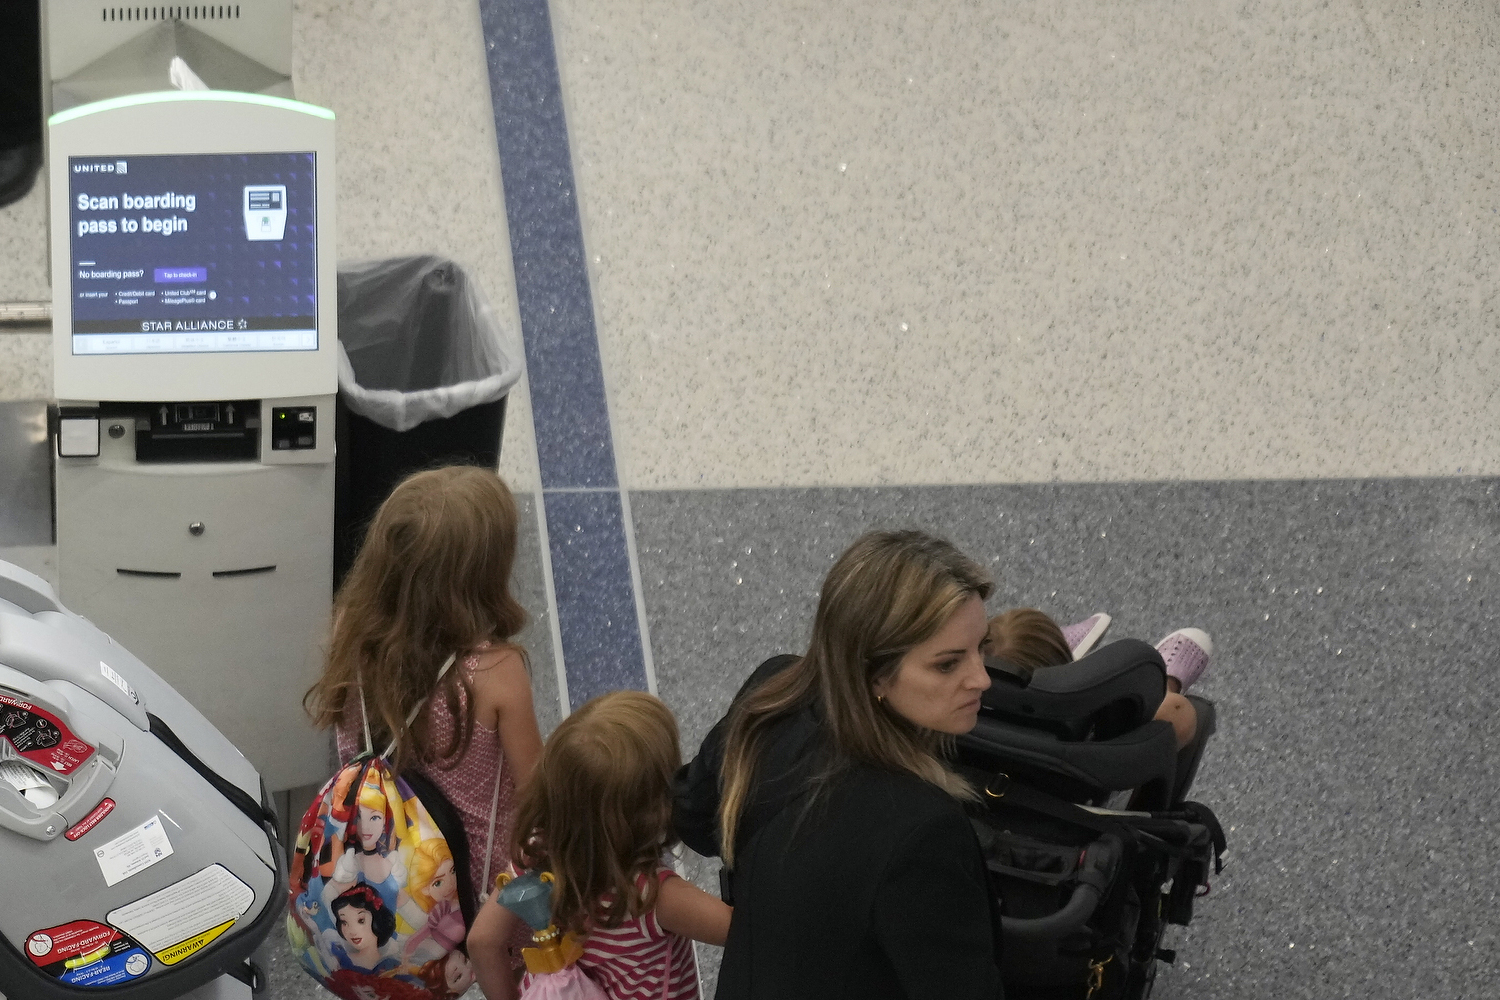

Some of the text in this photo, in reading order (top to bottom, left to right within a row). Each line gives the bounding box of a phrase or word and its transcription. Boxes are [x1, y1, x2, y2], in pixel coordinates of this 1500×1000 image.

[74, 164, 115, 173] UNITED
[77, 192, 196, 213] Scan boarding
[78, 216, 188, 237] pass to begin
[79, 269, 144, 279] No boarding pass?
[142, 320, 234, 331] STAR ALLIANCE
[57, 930, 111, 955] FORWARD-FACING
[162, 941, 200, 963] WARNING!
[71, 965, 111, 984] REAR-FACING
